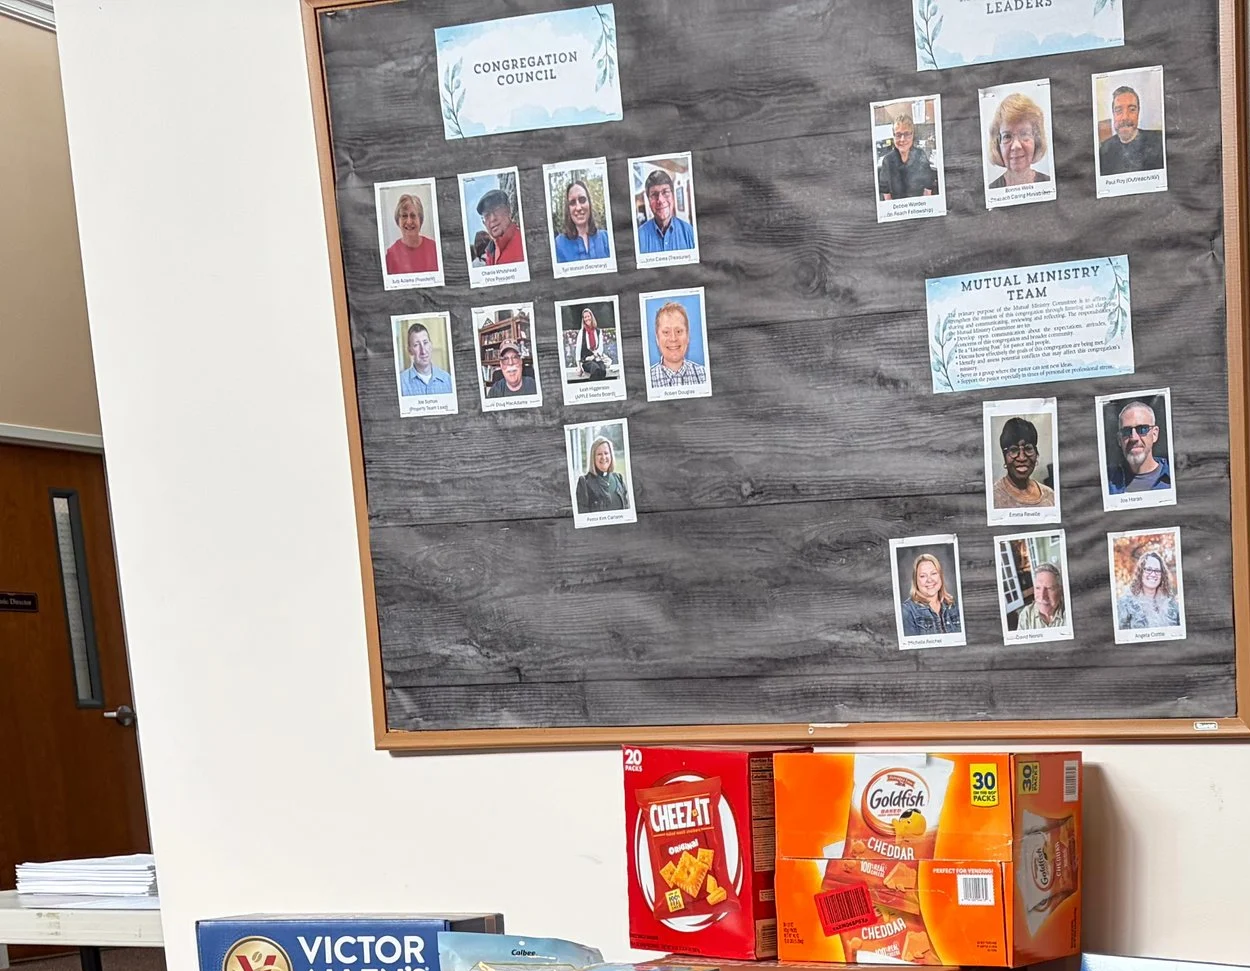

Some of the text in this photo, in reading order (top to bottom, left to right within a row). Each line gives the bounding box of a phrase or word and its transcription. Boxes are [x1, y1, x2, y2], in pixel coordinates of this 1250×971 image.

[986, 0, 1052, 15] LEADERS
[473, 51, 578, 74] CONGREGATION
[497, 68, 557, 86] COUNCIL
[961, 265, 1100, 292] MUTUAL MINISTRY
[1007, 287, 1048, 301] TEAM
[625, 749, 641, 765] 20
[625, 764, 642, 772] PACKS
[972, 772, 996, 791] 30
[870, 789, 925, 810] Goldfish
[973, 794, 996, 802] PACKS
[867, 836, 914, 859] CHEDDAR
[861, 917, 906, 941] CHEDDAR
[297, 935, 426, 964] VICTOR
[511, 949, 535, 957] Calbee
